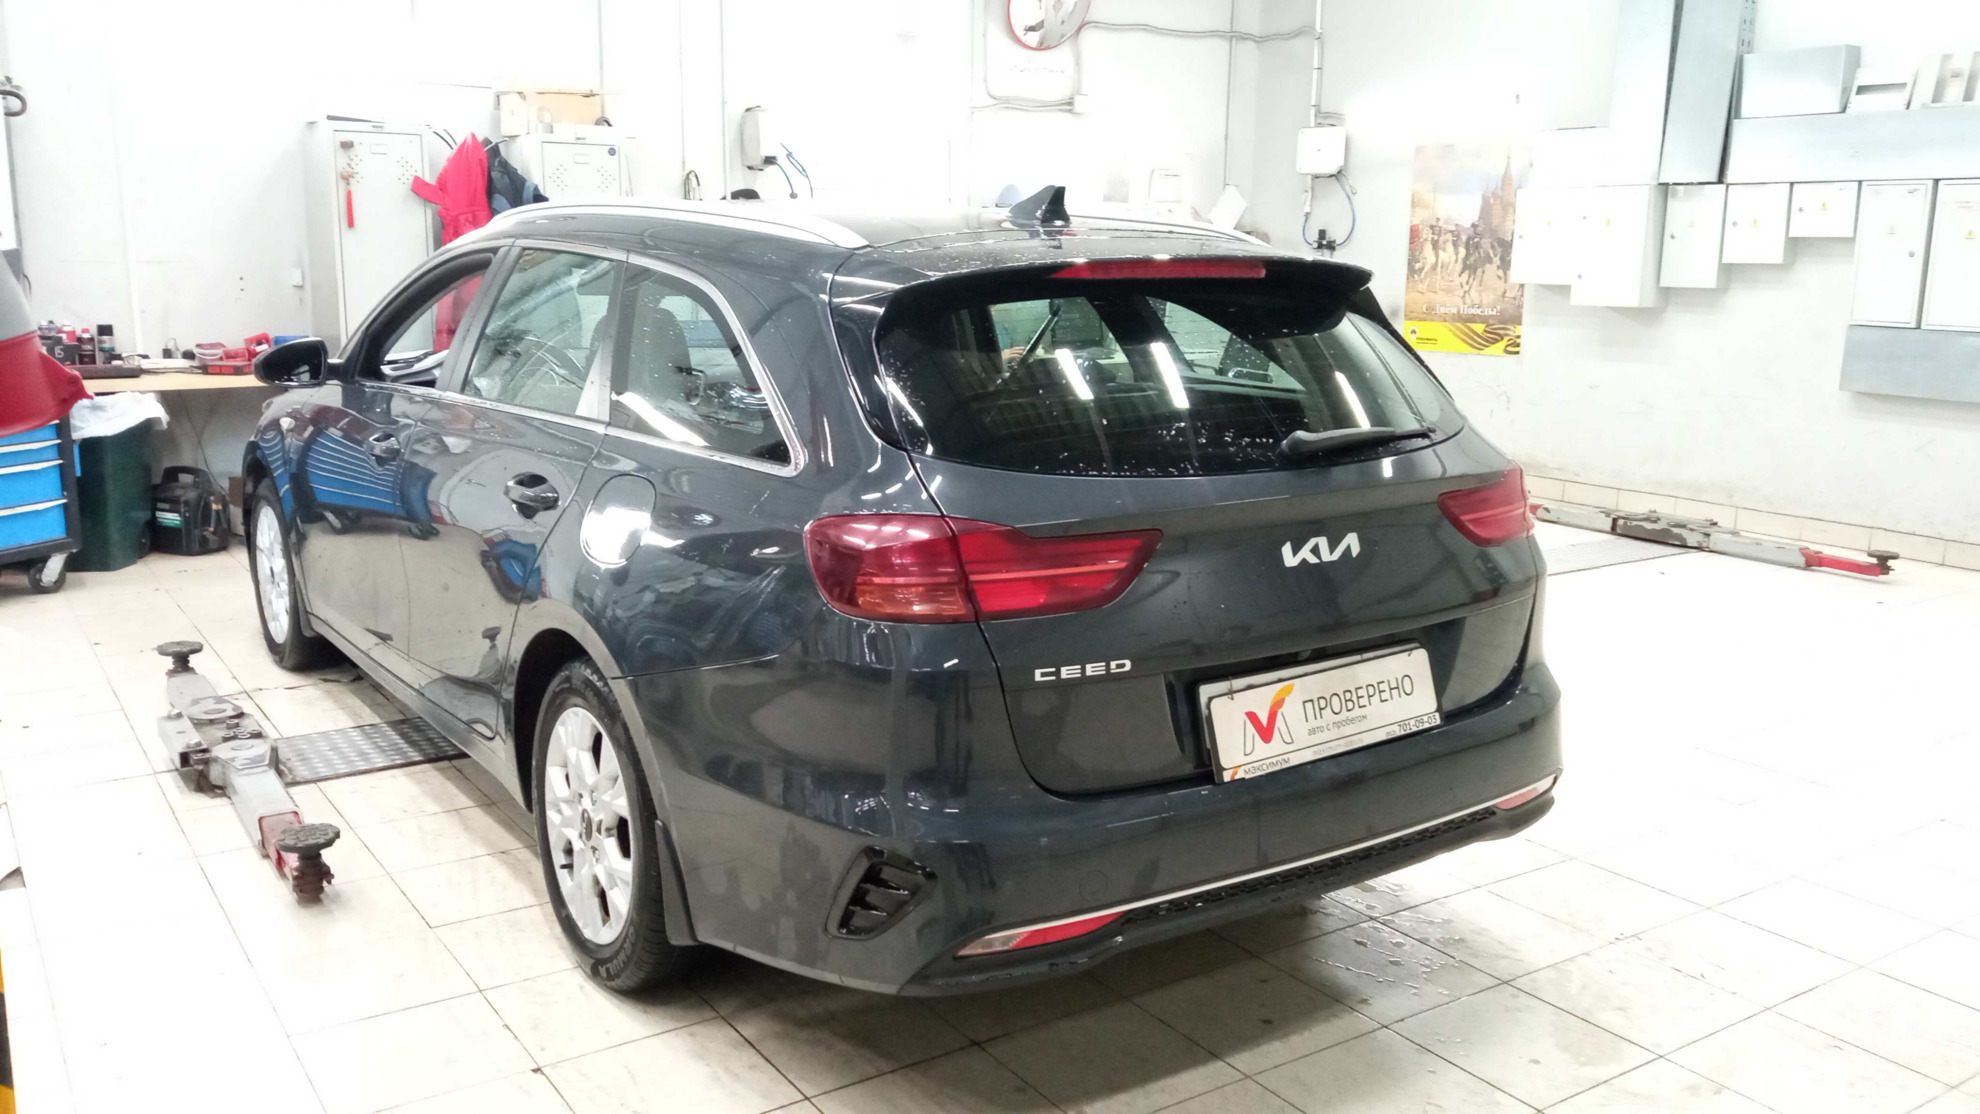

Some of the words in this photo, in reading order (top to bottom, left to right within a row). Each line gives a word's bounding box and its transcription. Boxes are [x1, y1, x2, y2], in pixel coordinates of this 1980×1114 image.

[1422, 303, 1432, 313] С
[1459, 303, 1501, 316] Победы!
[1281, 532, 1361, 568] KIA
[1034, 659, 1132, 682] CEED
[1302, 674, 1414, 723] ПРОВЕРЕНО
[1307, 725, 1325, 736] авто
[1326, 723, 1331, 731] с
[1332, 714, 1368, 730] пробегом
[1397, 714, 1438, 733] 701-09-03
[1243, 757, 1291, 776] максимум
